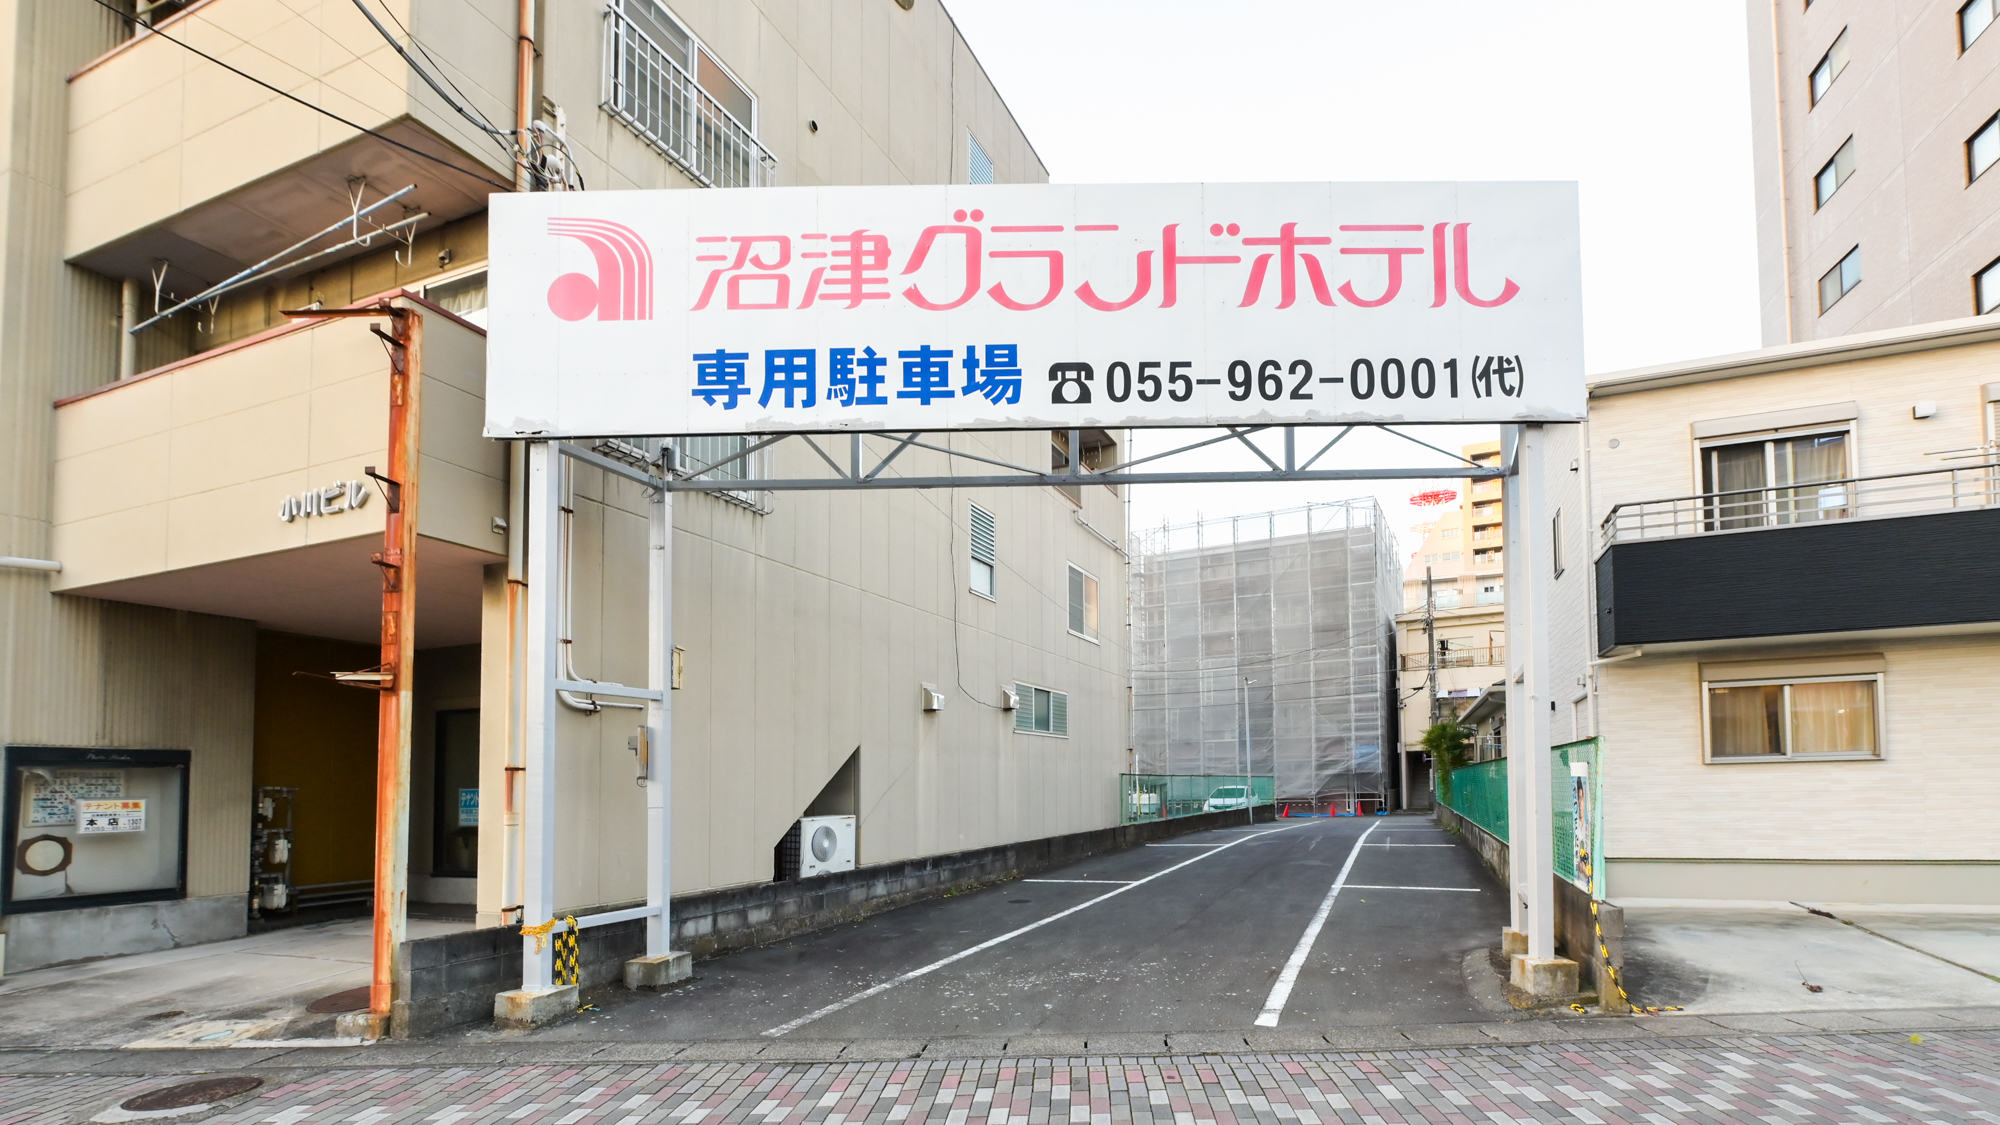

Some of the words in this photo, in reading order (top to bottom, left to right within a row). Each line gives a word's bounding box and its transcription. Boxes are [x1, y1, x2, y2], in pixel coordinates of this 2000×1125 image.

[691, 208, 1520, 311] 沼津グランドホテル
[691, 344, 1023, 410] 専用駐車場
[278, 480, 370, 522] 小川ビル
[84, 802, 141, 811] テナント募集
